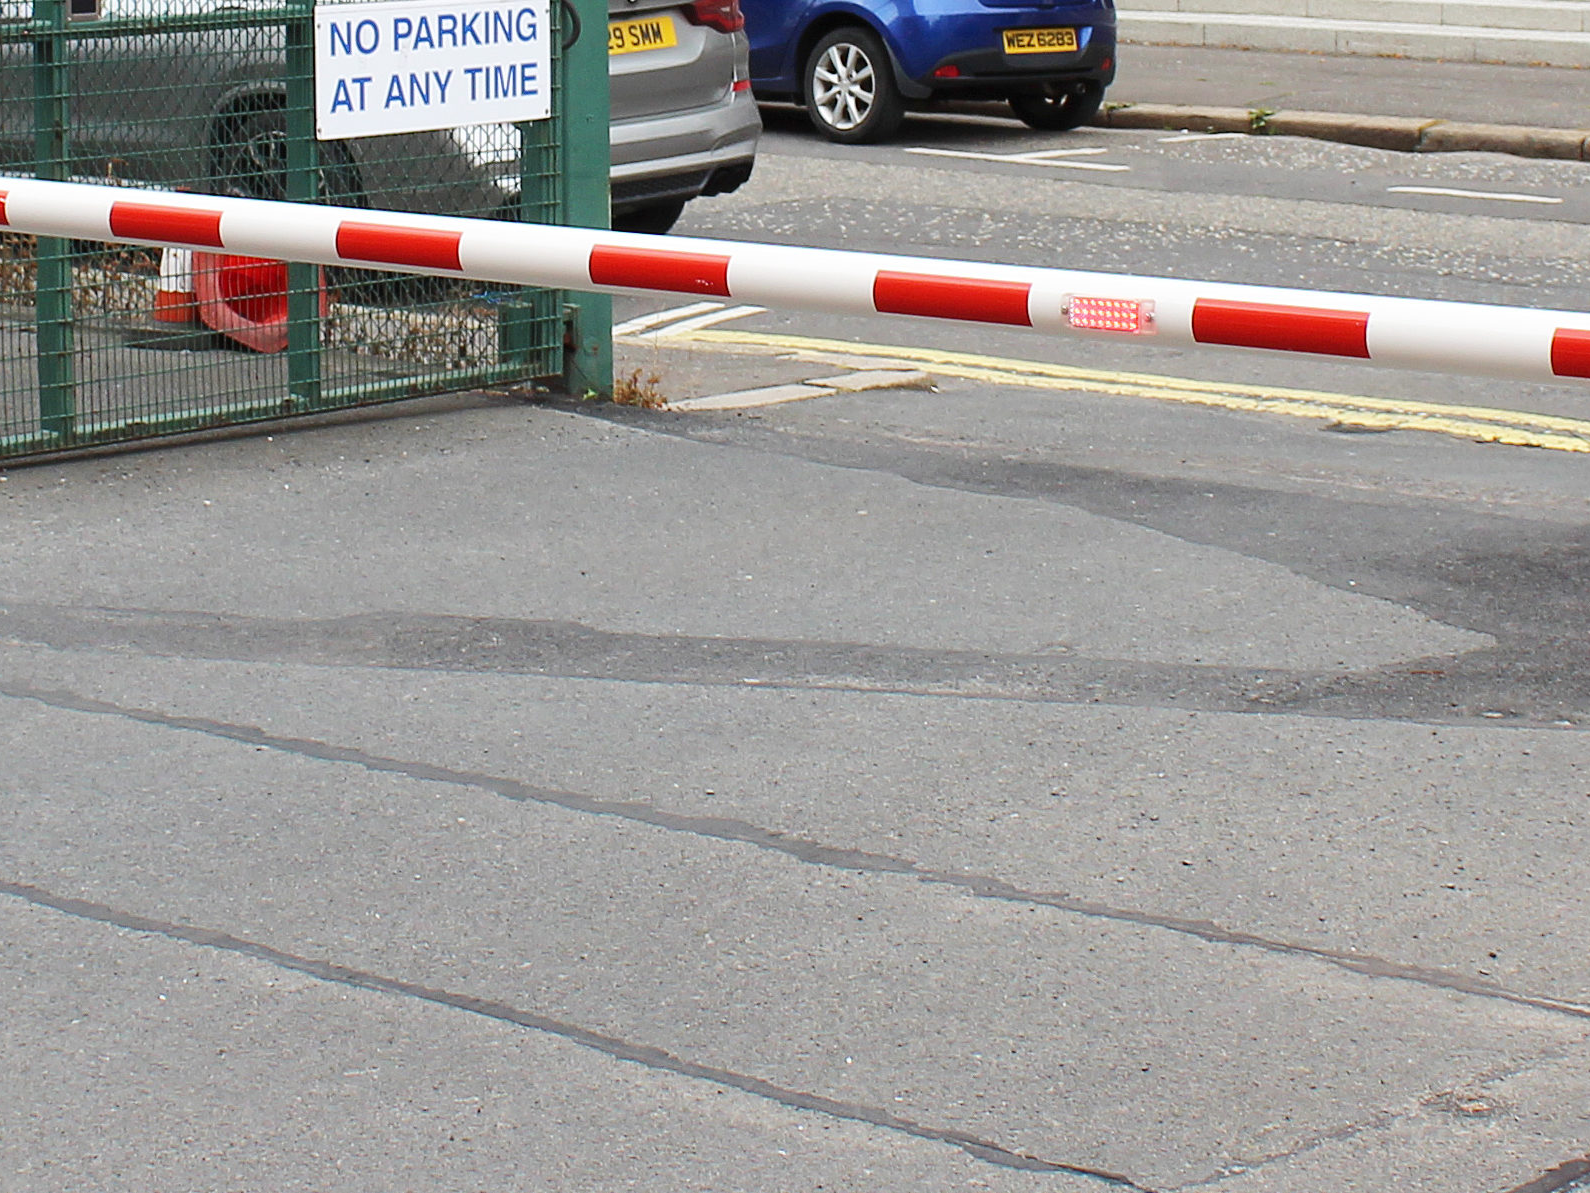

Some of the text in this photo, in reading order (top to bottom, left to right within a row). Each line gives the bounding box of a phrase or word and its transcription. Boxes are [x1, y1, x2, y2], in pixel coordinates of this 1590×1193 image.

[330, 8, 537, 56] NO PARKING
[628, 21, 664, 47] SMM
[1006, 34, 1036, 48] WEZ
[330, 63, 538, 113] AT ANY TIME
